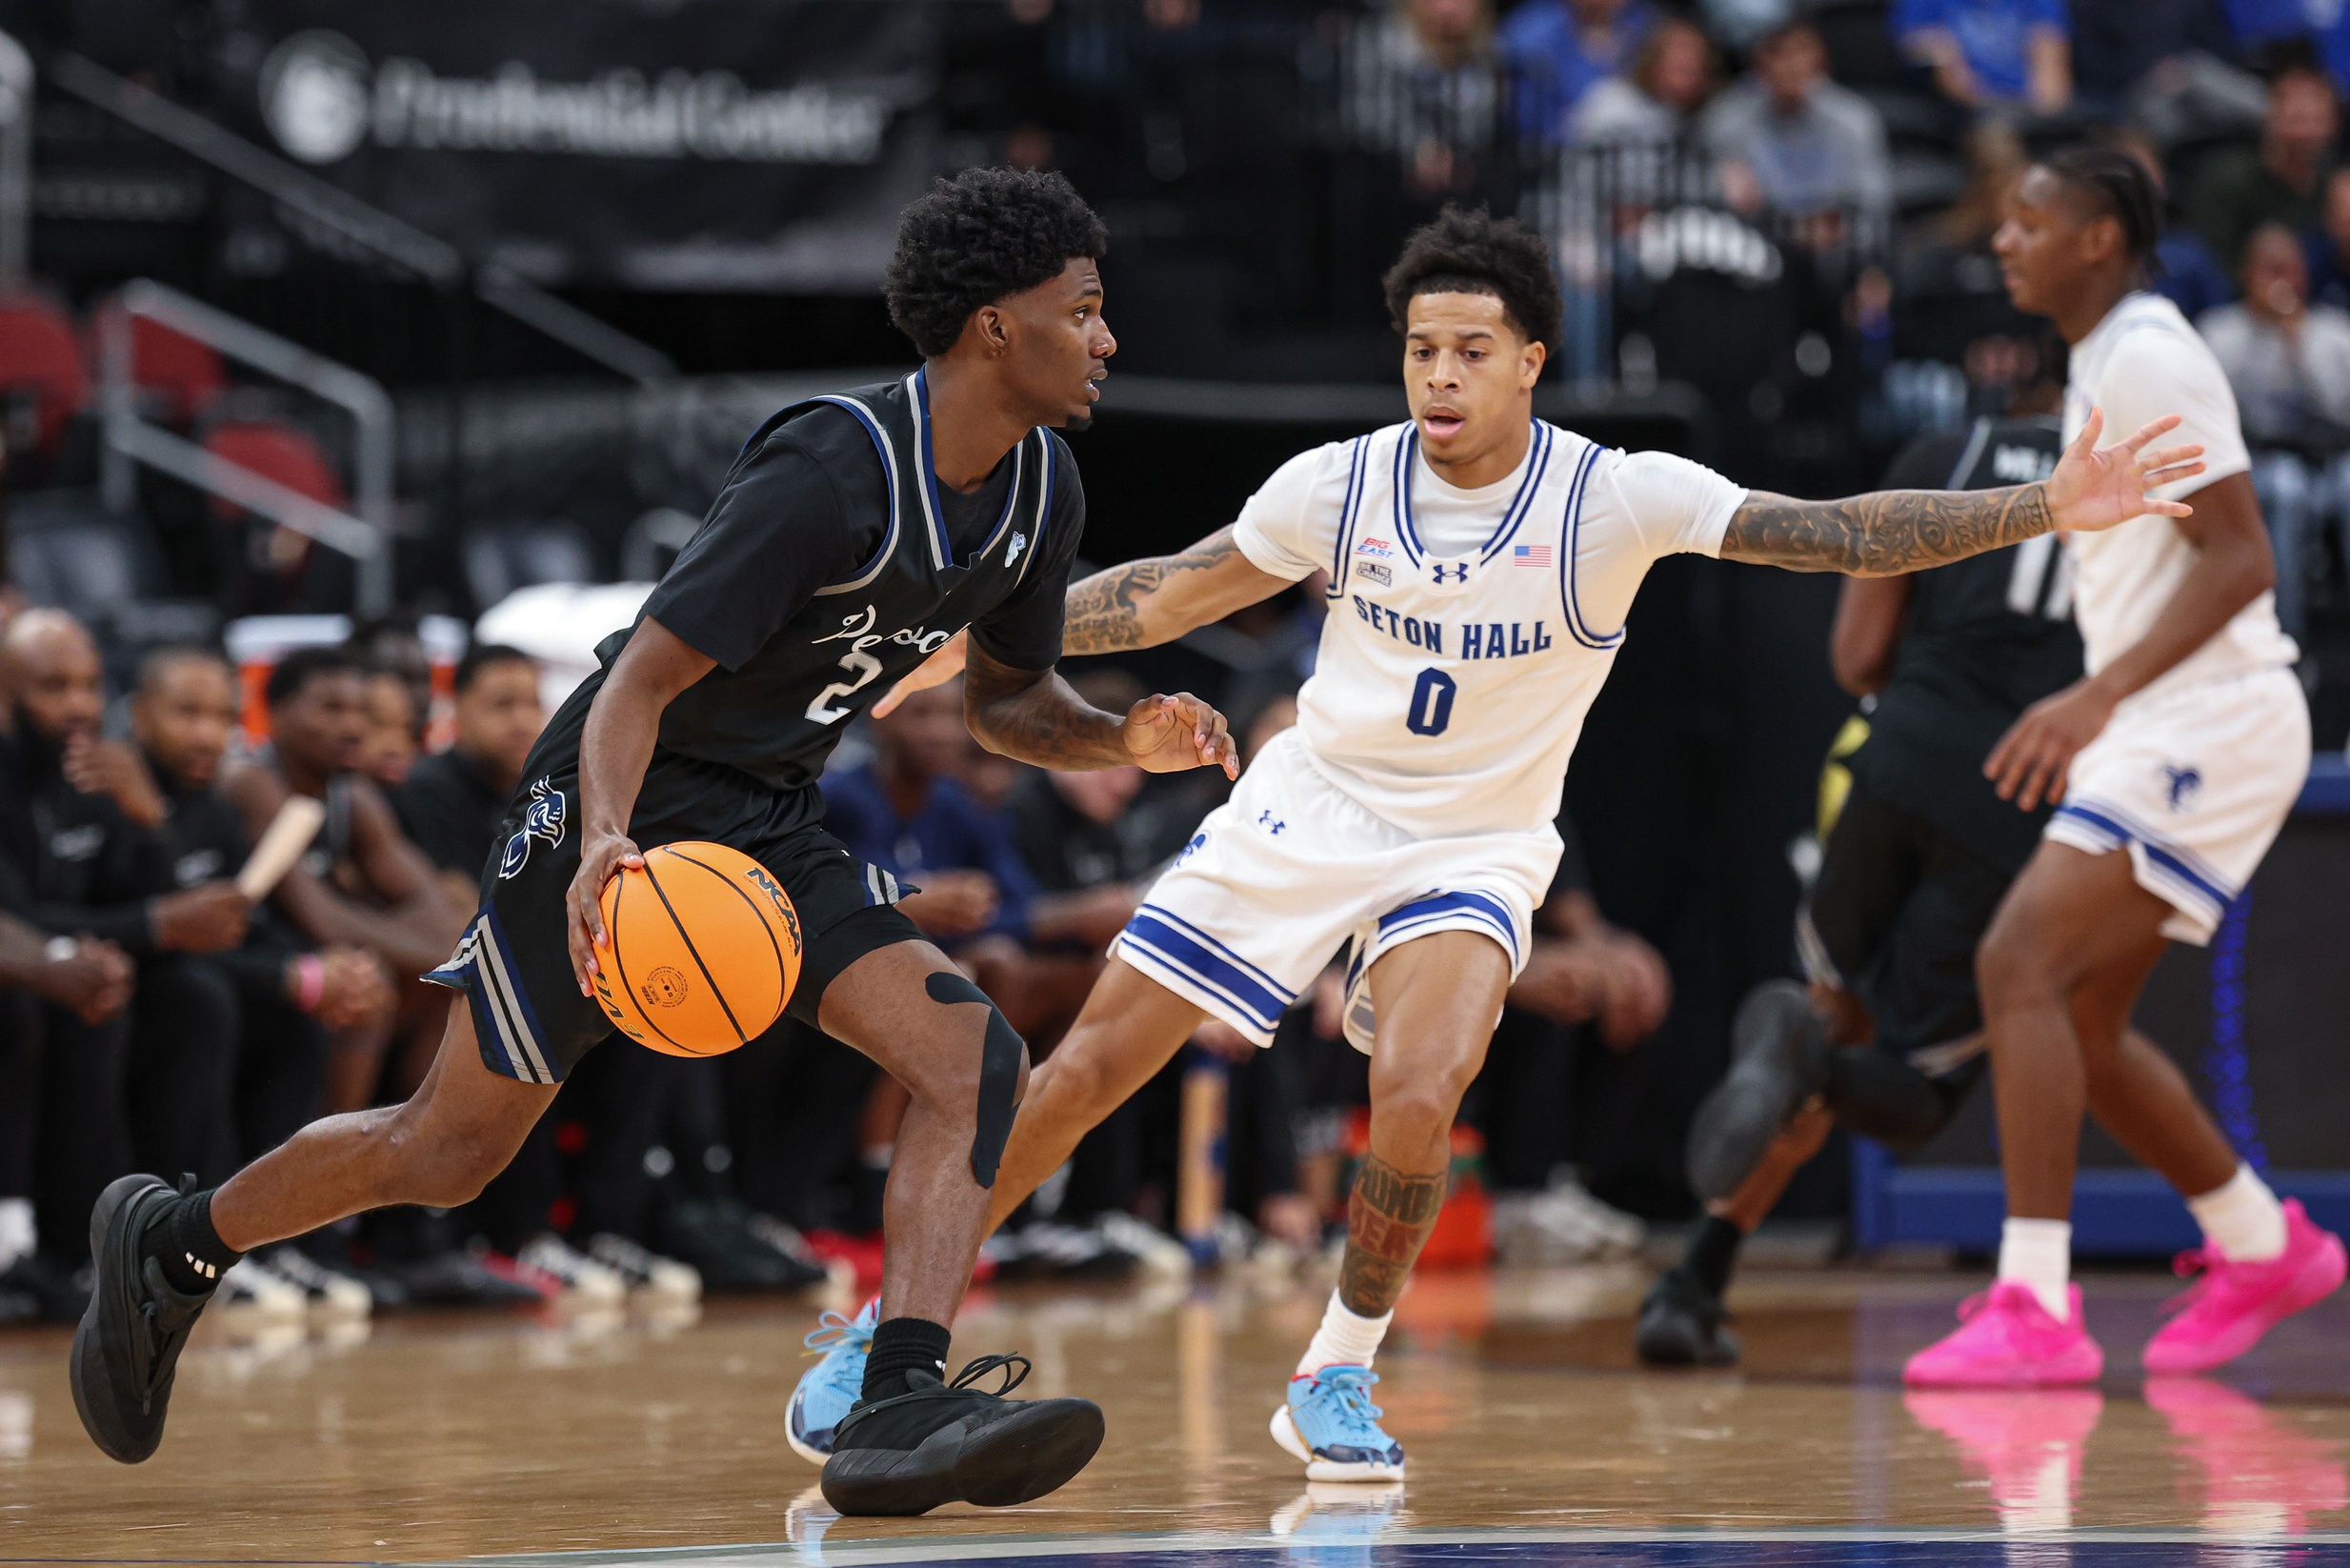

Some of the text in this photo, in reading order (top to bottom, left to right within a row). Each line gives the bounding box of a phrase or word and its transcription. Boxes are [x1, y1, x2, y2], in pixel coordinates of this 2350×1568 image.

[1357, 545, 1395, 558] EAST
[1364, 537, 1391, 549] BIG
[812, 604, 972, 653] Peac
[1353, 594, 1552, 659] SETON HALL
[804, 651, 883, 726] 2
[1406, 667, 1456, 737] 0
[744, 866, 801, 957] NCAA
